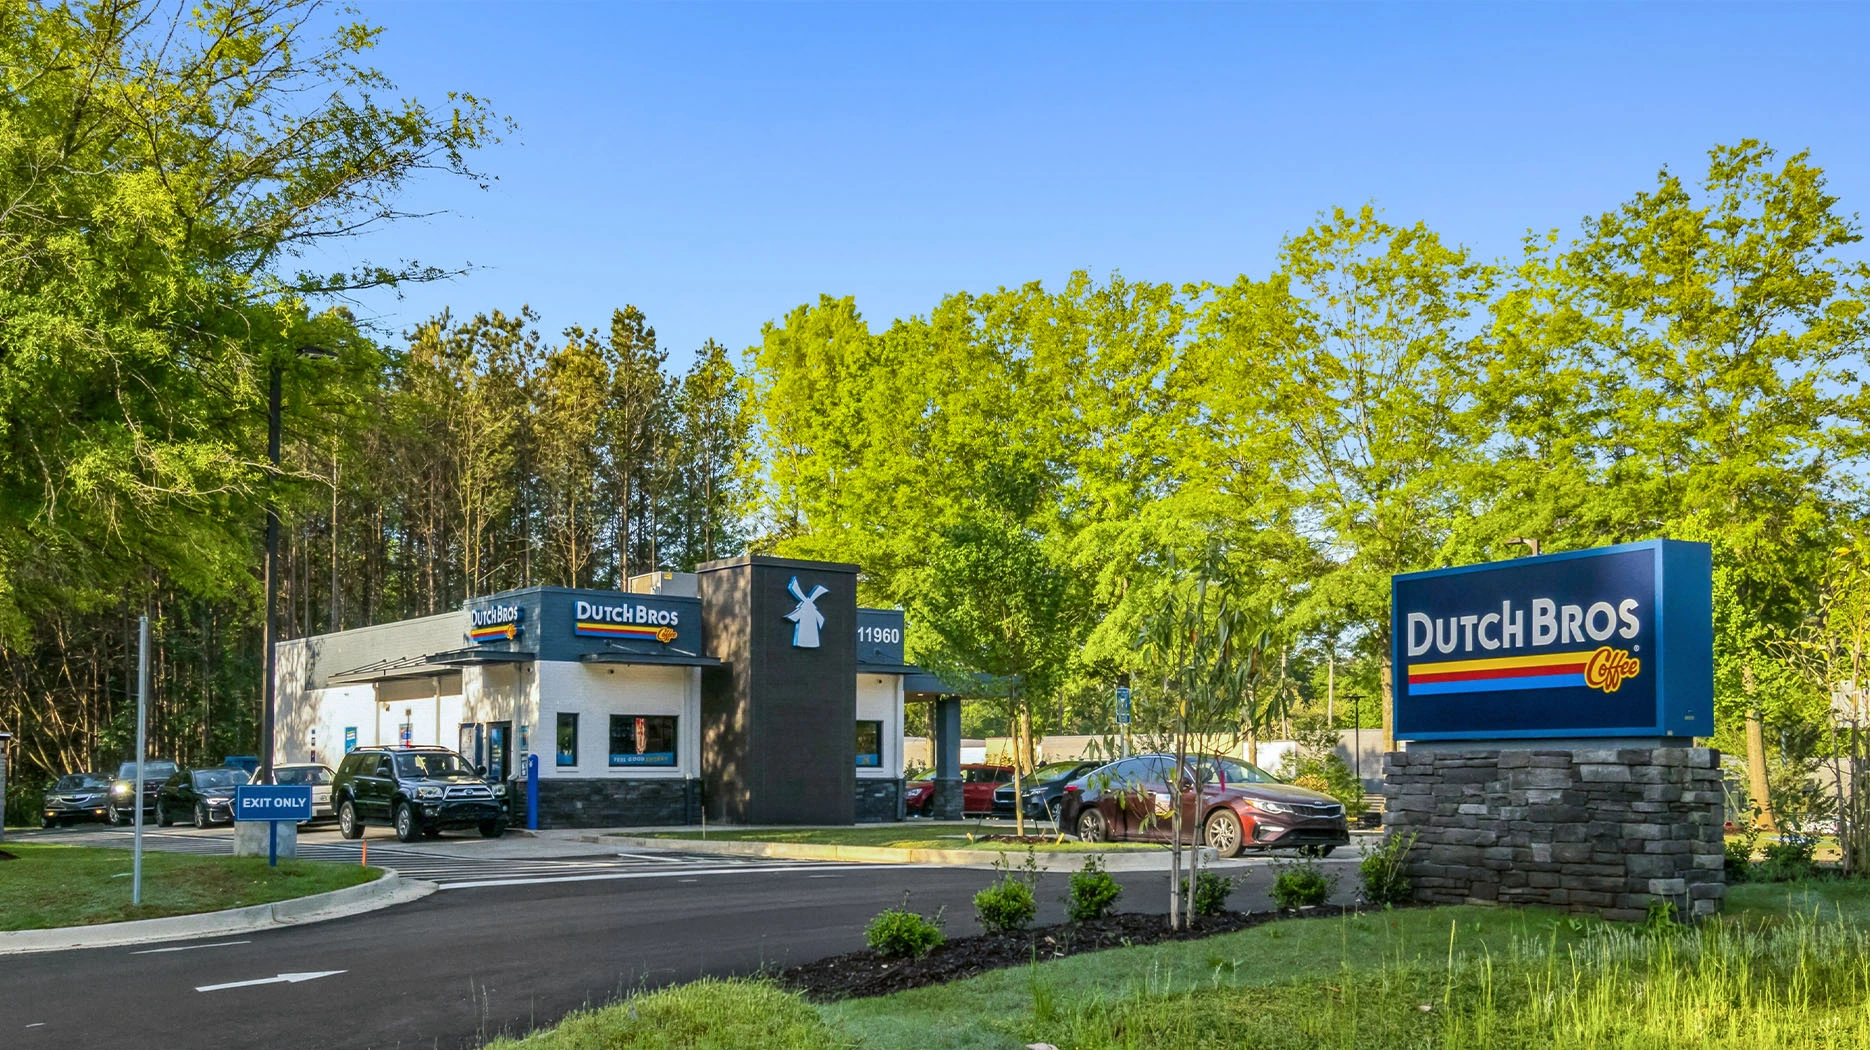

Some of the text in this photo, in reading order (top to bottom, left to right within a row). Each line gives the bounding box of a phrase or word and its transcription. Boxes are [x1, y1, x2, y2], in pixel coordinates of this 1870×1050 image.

[497, 604, 518, 623] BROS
[577, 600, 679, 626] DUTCH BROS
[857, 626, 900, 644] 11960
[1407, 597, 1640, 657] DUTCH BROS
[1585, 646, 1639, 692] Coffee
[242, 797, 307, 808] EXIT ONLY
